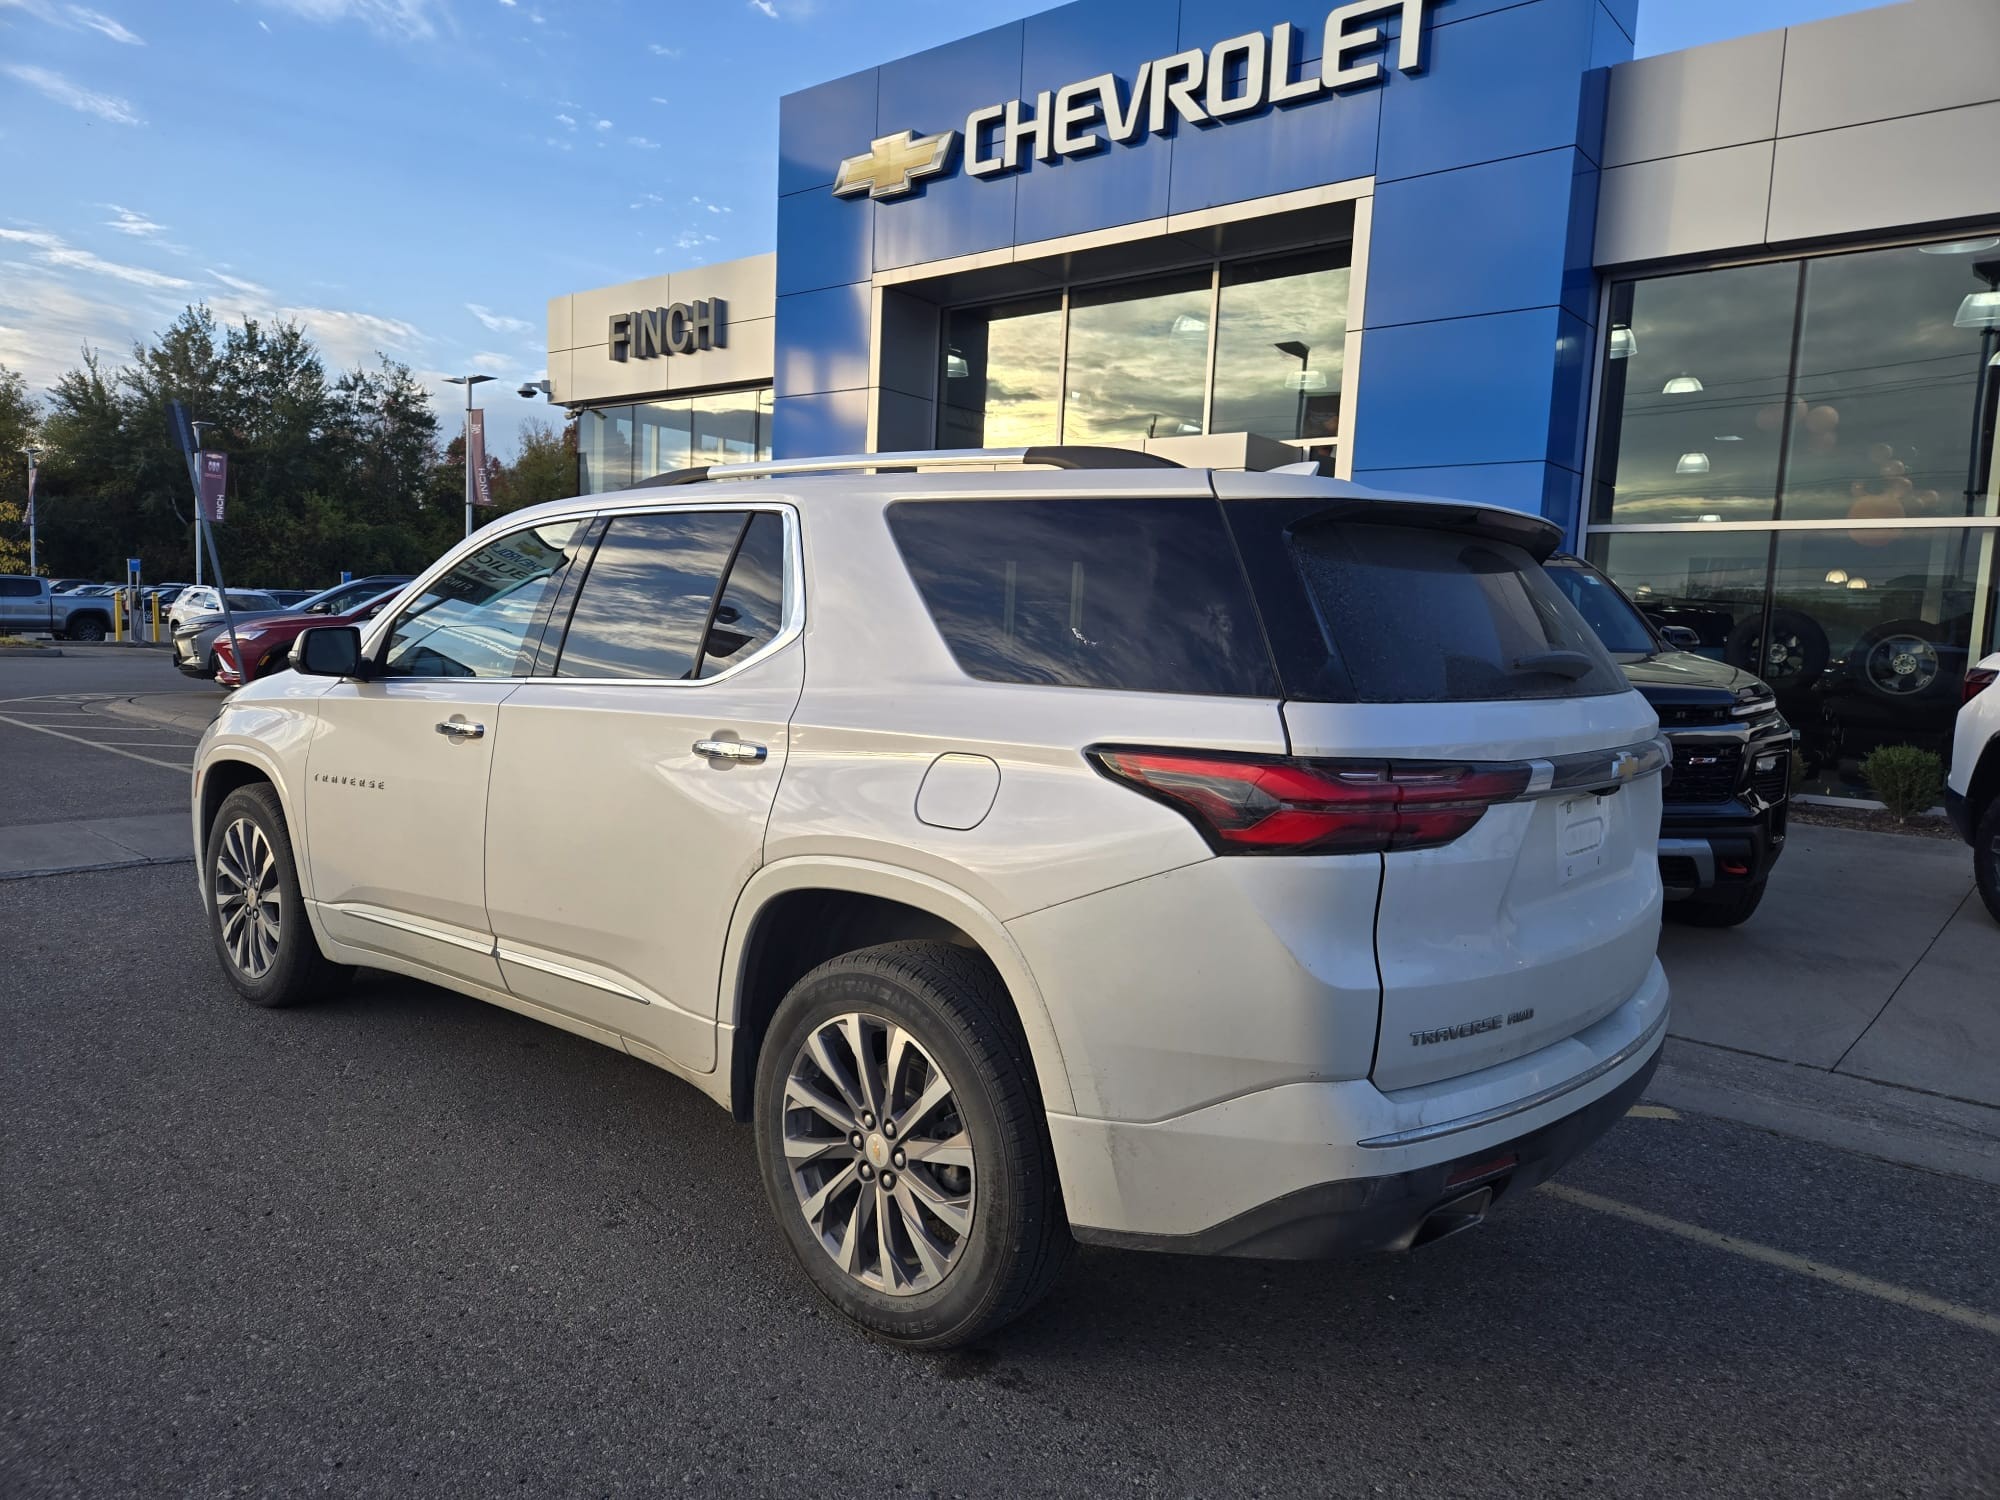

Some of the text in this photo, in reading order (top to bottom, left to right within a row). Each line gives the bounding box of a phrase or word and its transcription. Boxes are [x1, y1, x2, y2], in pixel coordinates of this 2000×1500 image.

[964, 0, 1424, 178] CHEVROLET
[608, 296, 728, 362] FINCH
[478, 467, 492, 502] FINCH
[216, 494, 225, 520] FINCH
[1409, 1014, 1504, 1046] TRAVERSE
